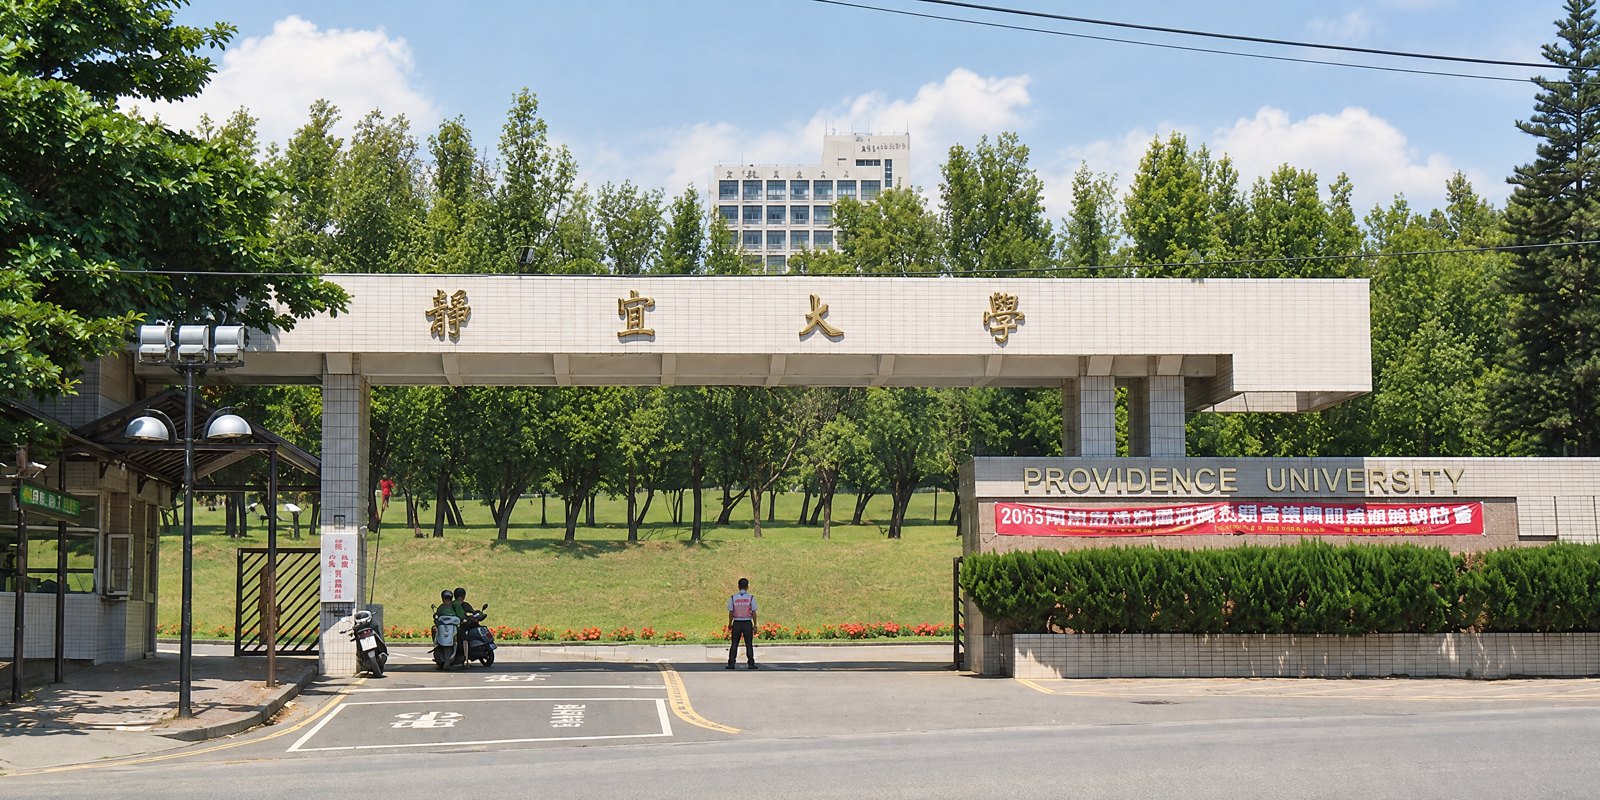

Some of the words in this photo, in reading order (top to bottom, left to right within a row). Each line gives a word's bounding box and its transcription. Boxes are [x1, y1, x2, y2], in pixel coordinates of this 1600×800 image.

[425, 289, 1025, 344] 靜宜大學
[1023, 467, 1238, 493] PROVIDENCE
[1265, 467, 1465, 494] UNIVERSITY
